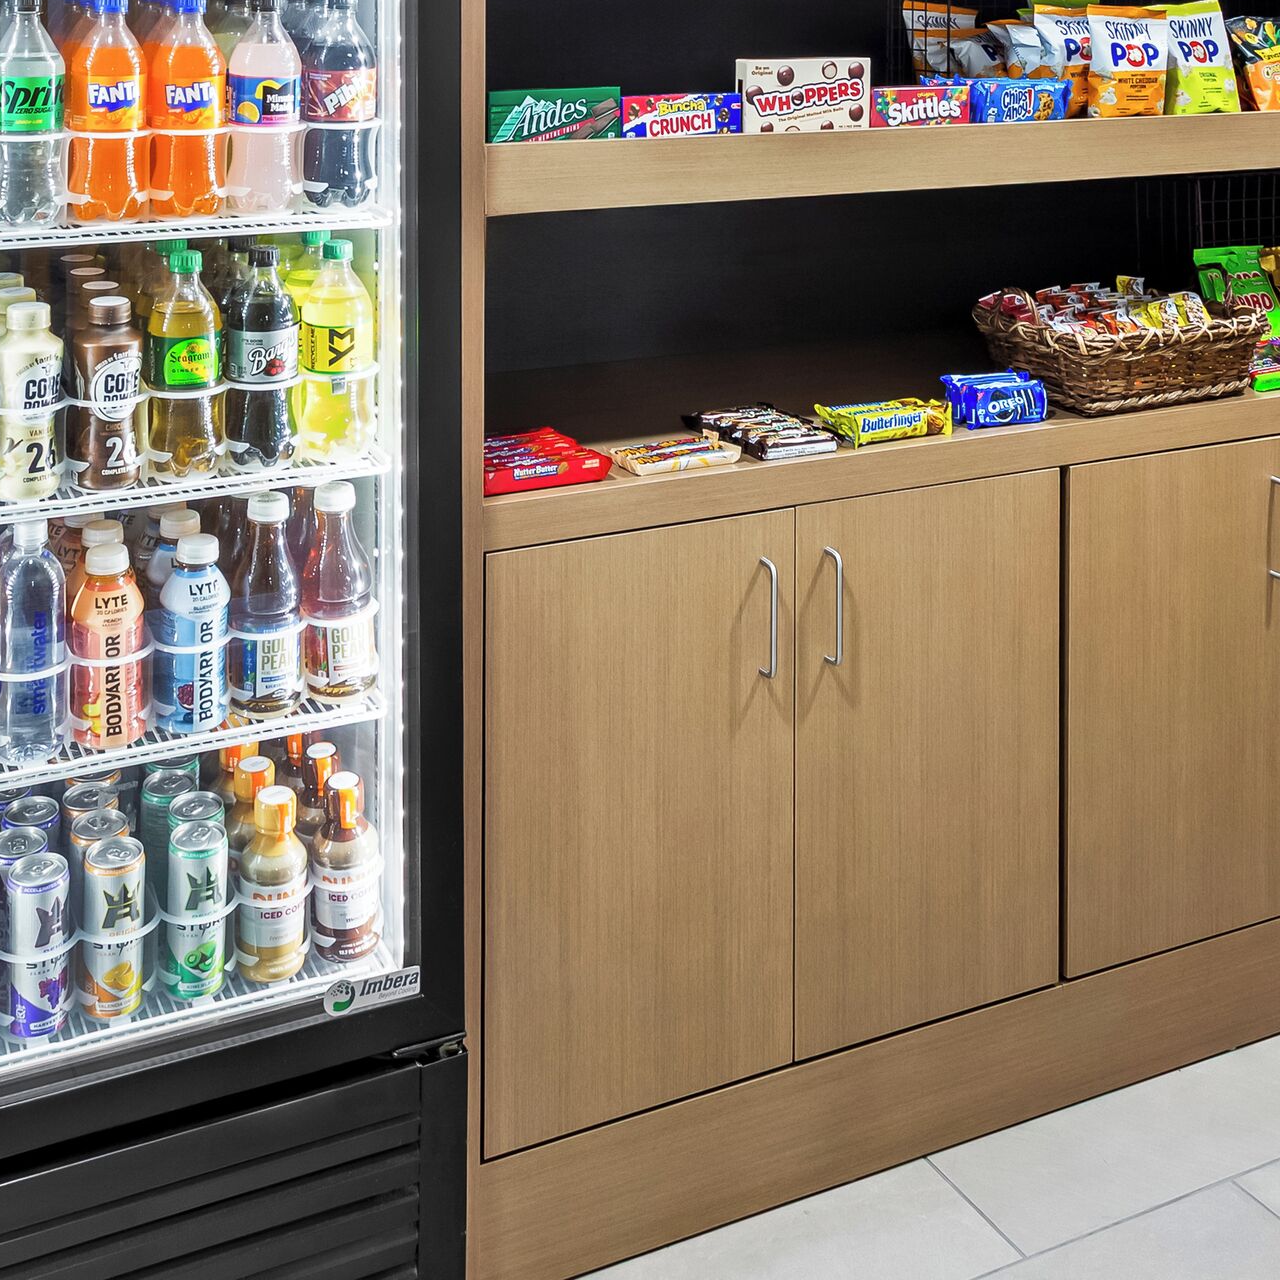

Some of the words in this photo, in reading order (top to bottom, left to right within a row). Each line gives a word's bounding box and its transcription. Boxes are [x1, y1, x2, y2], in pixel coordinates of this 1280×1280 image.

[1105, 21, 1152, 40] SKINNY
[1170, 17, 1213, 38] SKINNY
[1111, 42, 1159, 67] POP
[1177, 39, 1219, 63] POP
[756, 80, 861, 113] WHOPPERS
[1003, 89, 1028, 109] Chips
[509, 97, 588, 139] Andes
[659, 100, 705, 116] Buncha
[888, 98, 961, 127] Skittles
[649, 113, 711, 136] CRUNCH
[988, 397, 1023, 414] OREO
[861, 410, 922, 433] Butterfinger
[514, 466, 535, 477] Nutter
[535, 464, 559, 475] Butter
[95, 594, 128, 609] LYTE
[328, 892, 348, 902] ICED
[260, 911, 283, 920] ICED
[360, 972, 419, 995] Imbera
